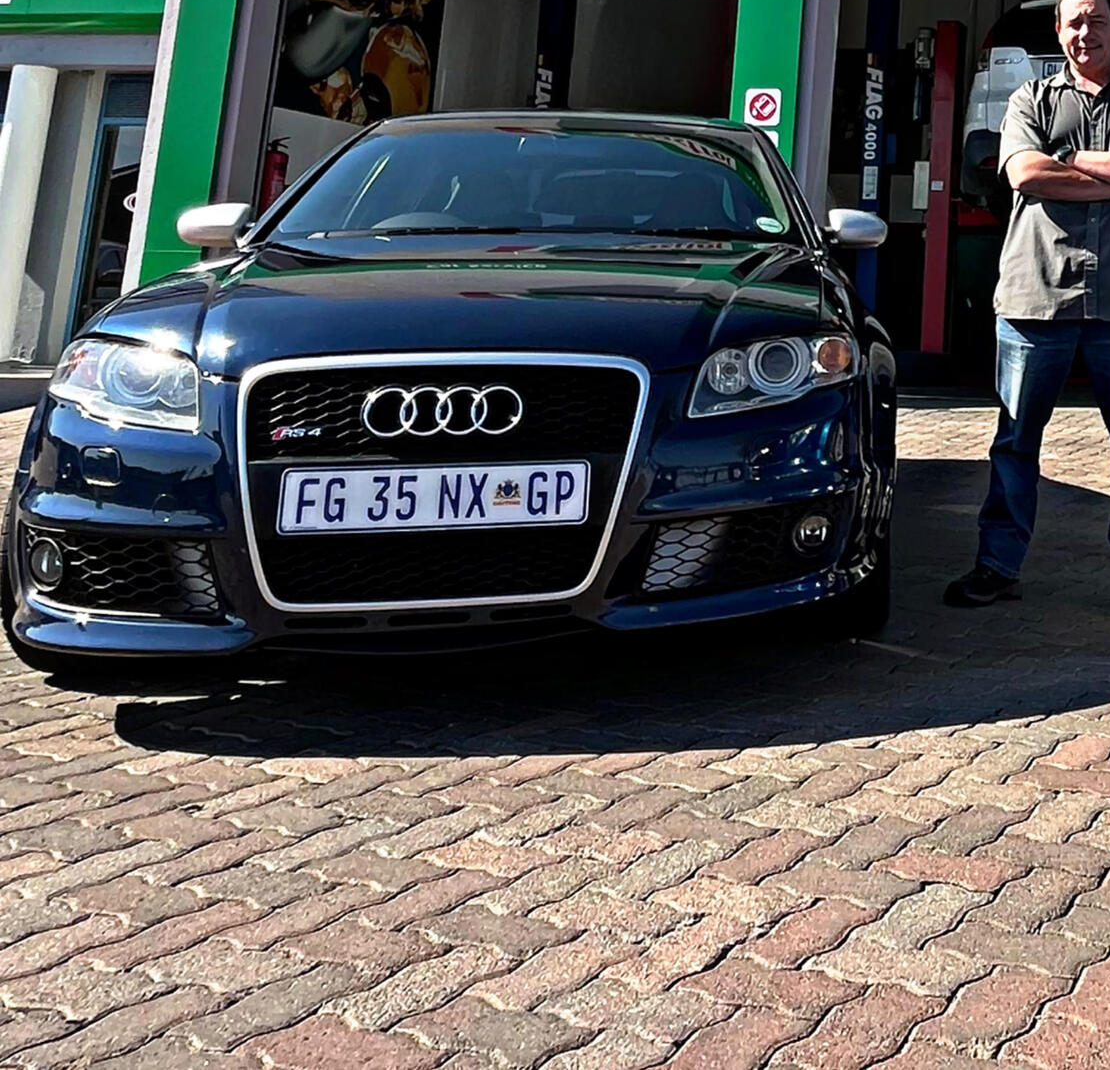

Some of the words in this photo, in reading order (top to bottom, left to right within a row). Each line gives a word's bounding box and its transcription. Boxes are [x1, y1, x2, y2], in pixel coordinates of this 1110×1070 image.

[535, 67, 553, 108] FLA
[865, 67, 884, 120] FLAG
[864, 123, 877, 160] 4000
[295, 478, 346, 524] FG
[367, 475, 418, 520] 35
[438, 473, 489, 519] NX
[527, 470, 575, 516] GP
